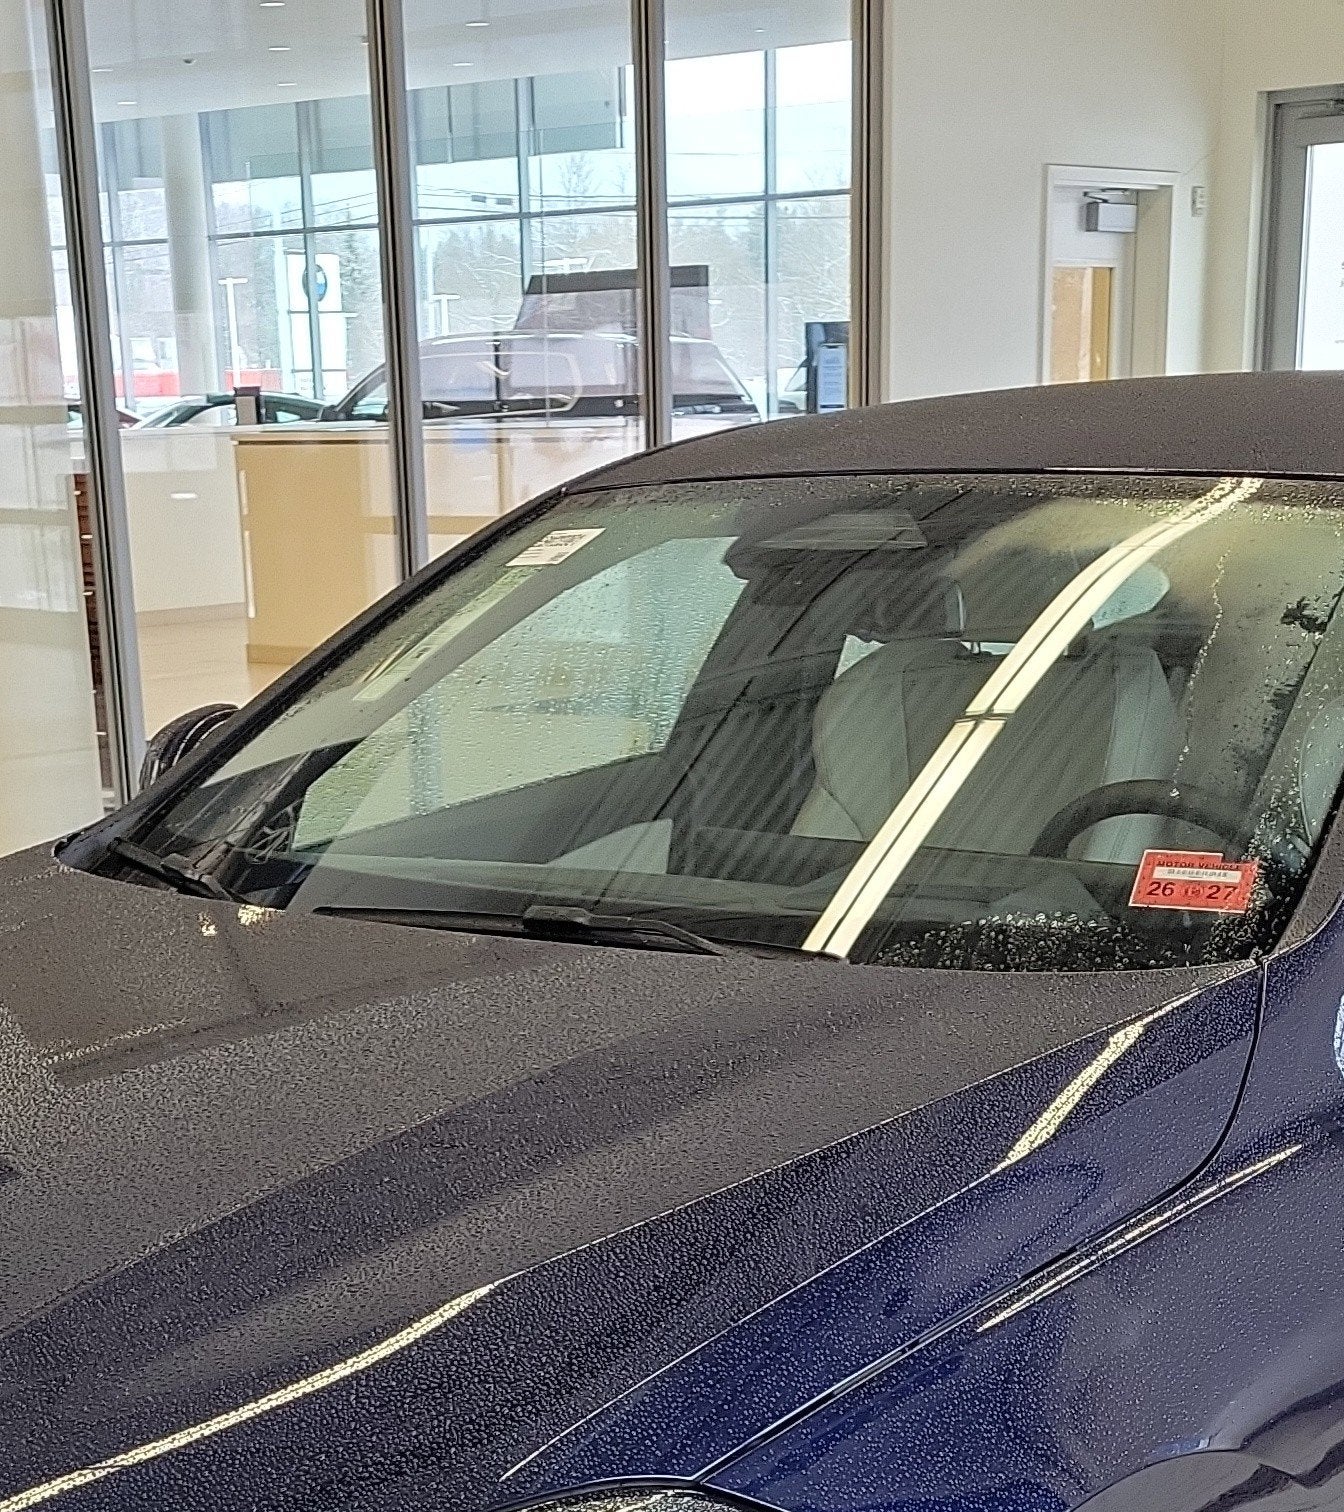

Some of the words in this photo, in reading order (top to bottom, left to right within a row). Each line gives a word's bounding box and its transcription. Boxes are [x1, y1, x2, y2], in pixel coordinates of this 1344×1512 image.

[1156, 860, 1195, 869] MOTOR
[1198, 861, 1240, 870] VEHICLE
[1146, 881, 1177, 897] 26
[1206, 884, 1238, 901] 27
